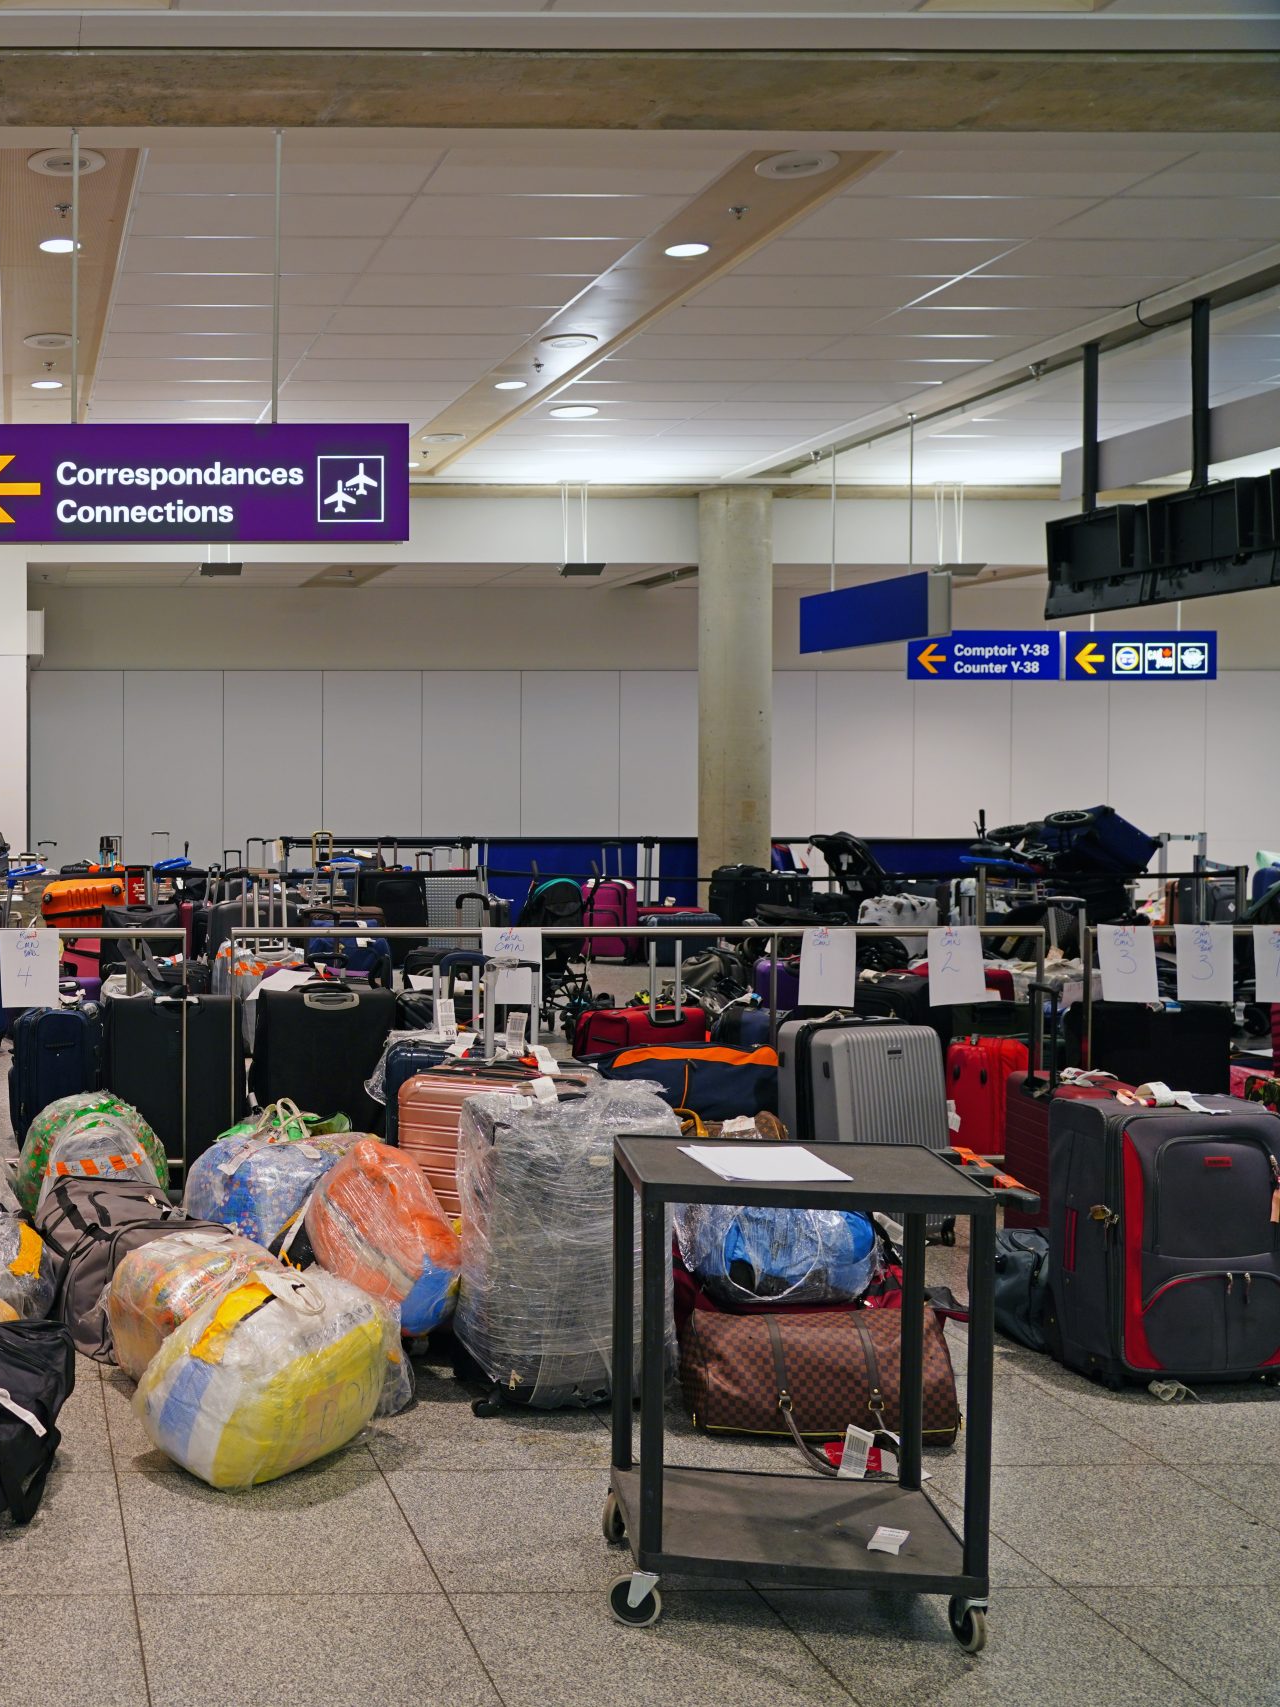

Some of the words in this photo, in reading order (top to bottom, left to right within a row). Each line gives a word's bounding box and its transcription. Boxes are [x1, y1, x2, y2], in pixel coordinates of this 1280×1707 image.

[56, 461, 304, 491] Correspondances
[56, 498, 234, 524] Connections
[954, 643, 1018, 659] Comptoir
[1020, 643, 1050, 656] Y-38
[953, 660, 1008, 674] Counter
[1010, 660, 1040, 673] Y-38
[494, 942, 525, 952] CMN
[941, 951, 960, 974] 2
[1116, 949, 1138, 976] 3
[1191, 954, 1214, 981] 3
[17, 966, 33, 988] 4
